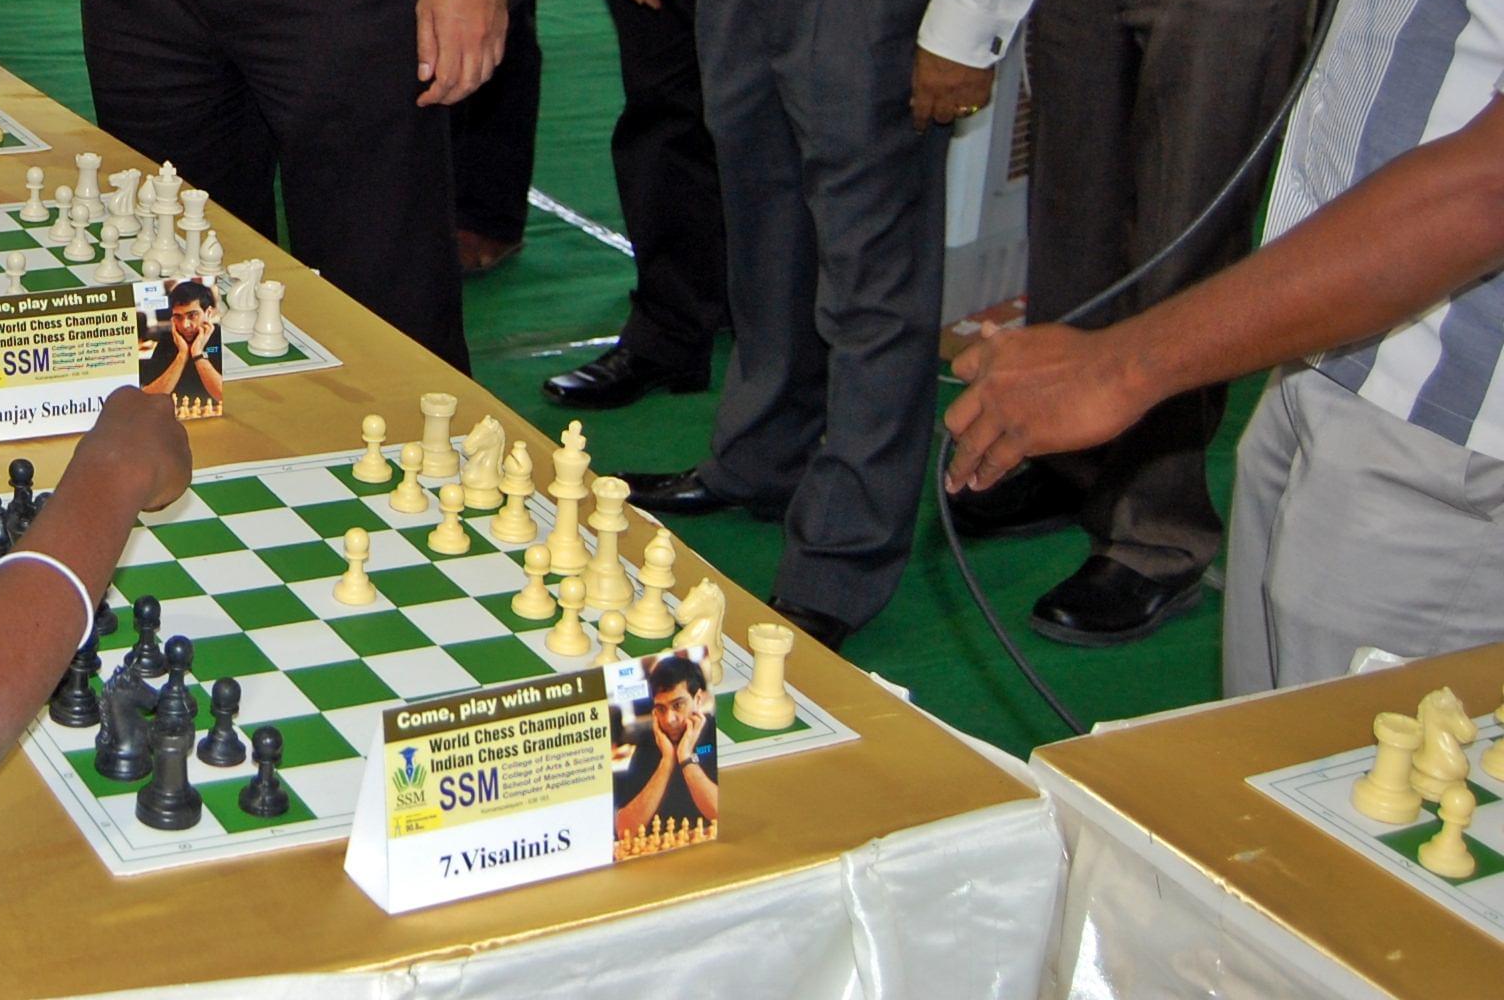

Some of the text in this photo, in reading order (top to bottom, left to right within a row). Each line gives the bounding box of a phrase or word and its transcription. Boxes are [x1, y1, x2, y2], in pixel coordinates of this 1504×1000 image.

[19, 298, 48, 313] play
[52, 294, 83, 307] with
[86, 293, 108, 304] me
[112, 290, 116, 301] !
[30, 317, 63, 330] Chess
[65, 312, 118, 329] Champion
[121, 312, 128, 322] &
[33, 332, 65, 345] Chess
[68, 325, 135, 341] Grandmaster
[3, 348, 50, 376] SSM
[397, 677, 583, 729] Come, play with me !
[429, 706, 599, 754] World Chess Champion &
[430, 725, 608, 773] Indian Chess Grandmaster
[501, 758, 534, 771] College
[545, 746, 594, 762] Engineering
[502, 768, 534, 781] College
[573, 754, 605, 767] Science
[502, 778, 532, 790] School
[543, 764, 595, 781] Management
[396, 790, 425, 807] SSM
[439, 767, 499, 811] SSM
[502, 775, 596, 800] Computer Applications
[440, 828, 571, 878] 7.Visalini.S
